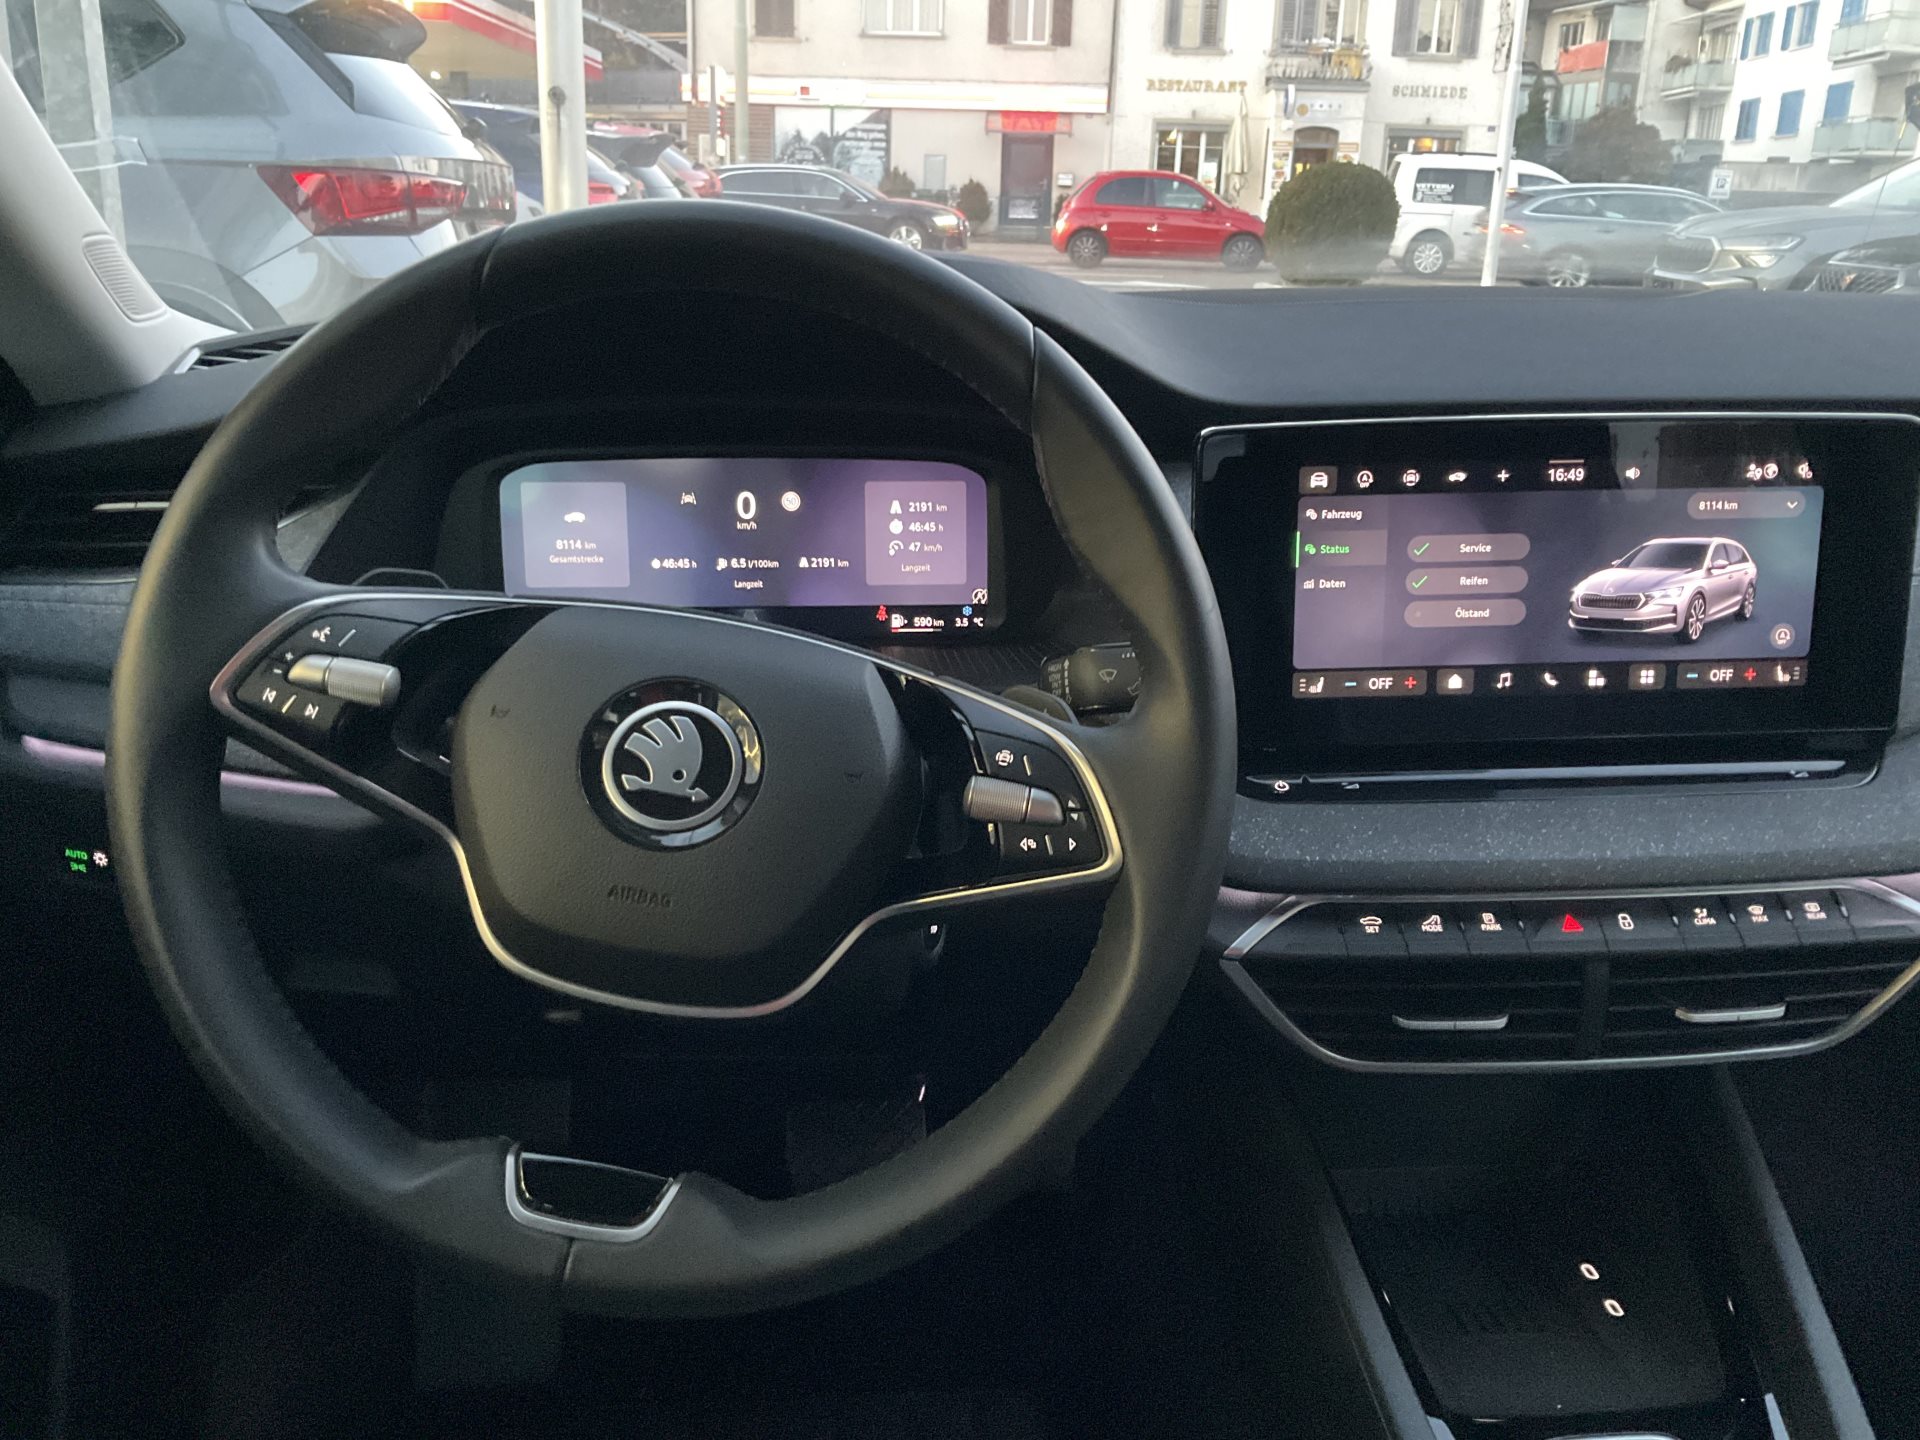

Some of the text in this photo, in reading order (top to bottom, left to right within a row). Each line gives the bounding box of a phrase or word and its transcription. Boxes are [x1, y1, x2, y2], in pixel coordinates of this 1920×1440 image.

[1146, 79, 1247, 94] RESTAURANT
[1392, 85, 1468, 99] SCHMIEDE
[1549, 468, 1584, 482] 16:49
[736, 491, 756, 520] 0
[909, 502, 948, 512] 2191 km
[1699, 501, 1738, 510] 8114 km
[1322, 510, 1362, 520] Fahrzeug
[737, 522, 757, 530] km/h
[909, 522, 944, 532] 46:45 h
[556, 540, 596, 550] 8114 km
[909, 542, 943, 552] 47 km/h
[1320, 544, 1350, 554] Status
[1460, 543, 1491, 553] Service
[550, 554, 604, 564] Gesamtstrecke
[662, 558, 697, 568] 46:45 h
[731, 558, 779, 568] 6.5 l/100km
[811, 558, 849, 568] 2191 km
[902, 564, 931, 574] Langzeit
[734, 580, 764, 590] Langzeit
[1319, 580, 1346, 588] Daten
[1460, 576, 1488, 586] Reifen
[1455, 607, 1490, 618] Ölstand
[914, 617, 944, 627] 590 km
[955, 618, 984, 627] 3.5 °C
[1049, 674, 1060, 682] LOW
[1710, 668, 1734, 681] OFF
[1369, 678, 1393, 690] OFF
[65, 849, 88, 860] AUTO
[607, 884, 672, 908] AIRBAG
[1694, 917, 1716, 925] CLIMA
[1752, 915, 1769, 923] MAX
[1422, 924, 1443, 932] MODE
